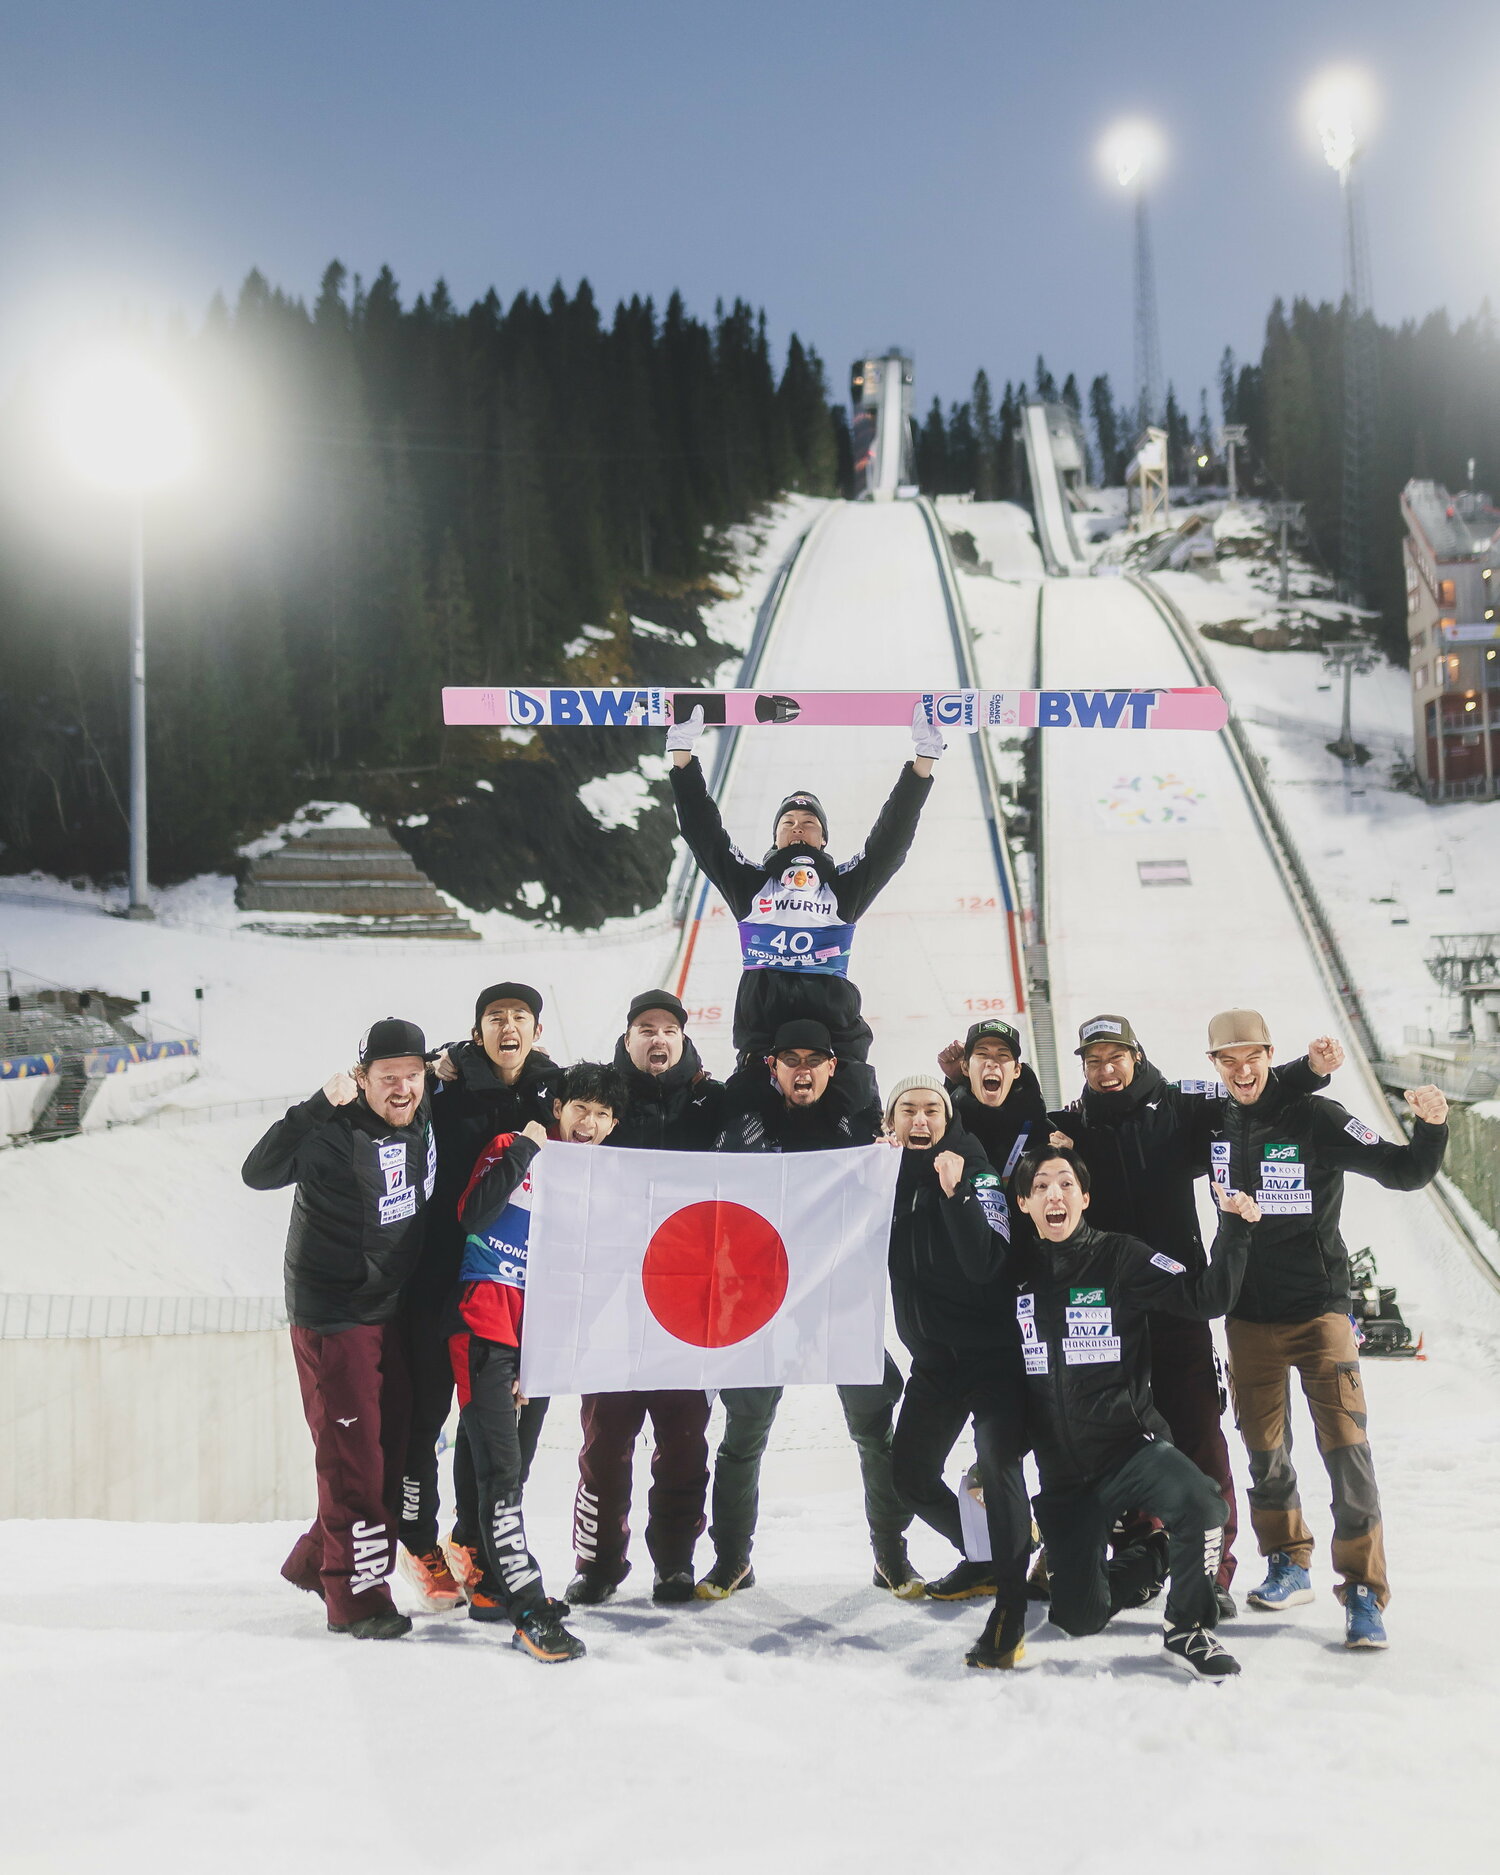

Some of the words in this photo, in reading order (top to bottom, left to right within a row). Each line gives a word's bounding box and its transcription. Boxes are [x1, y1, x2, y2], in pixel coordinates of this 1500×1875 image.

[651, 692, 660, 715] BWT
[1038, 692, 1156, 729] BWT
[964, 703, 973, 726] BWT
[774, 899, 832, 915] WÜRTH
[955, 896, 997, 910] 124
[769, 930, 814, 955] 40
[687, 1006, 722, 1020] HS
[963, 998, 1006, 1012] 138
[1264, 1179, 1290, 1190] ANA
[382, 1190, 413, 1208] INPEX
[1070, 1325, 1097, 1336] ANA
[1024, 1346, 1044, 1356] INPEX
[402, 1475, 420, 1521] JAPAN
[492, 1499, 541, 1594] JAPAN
